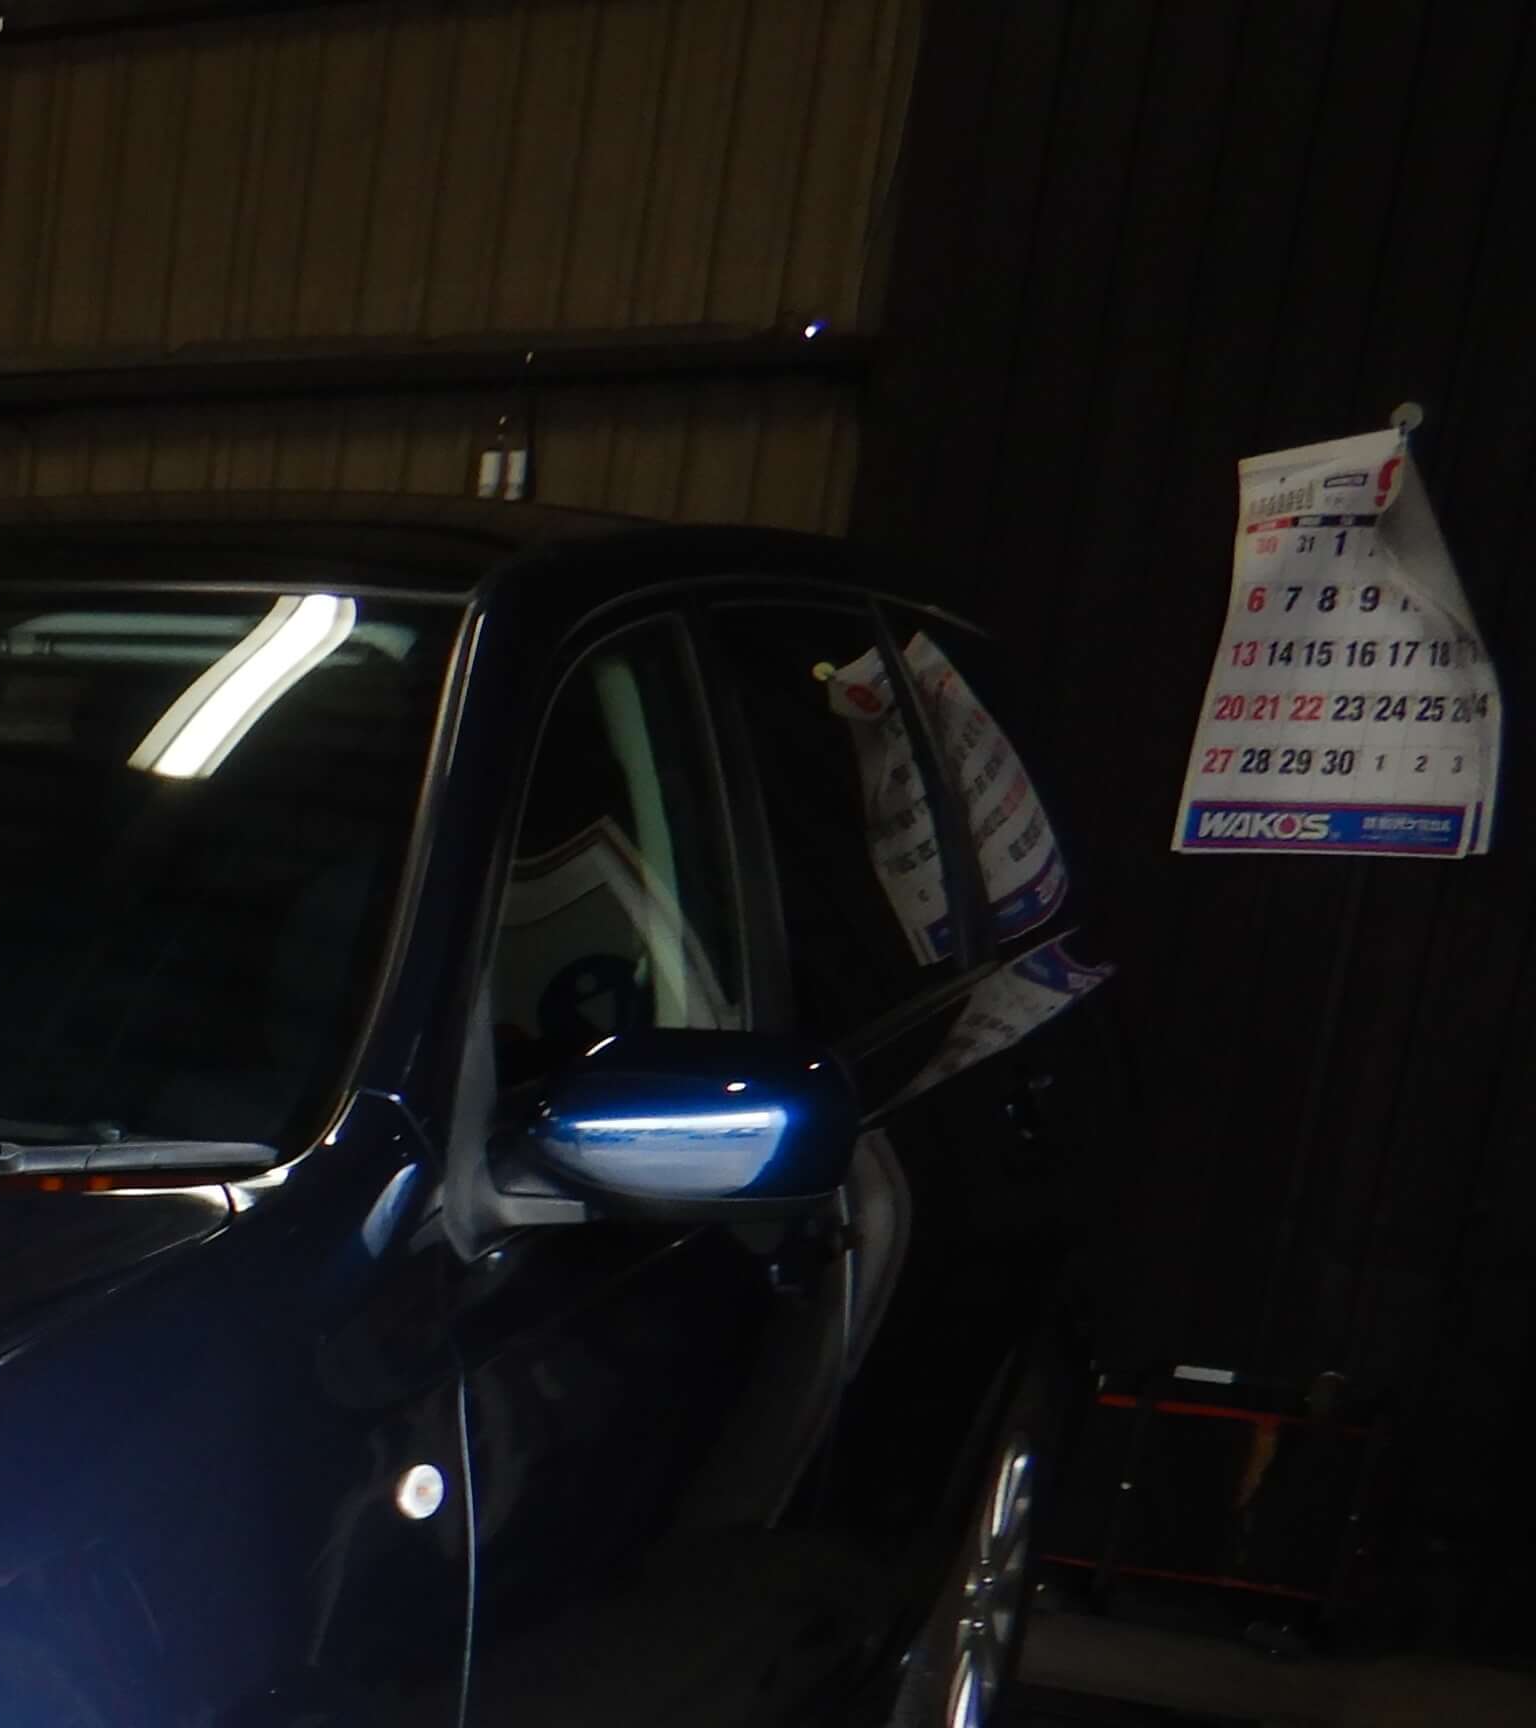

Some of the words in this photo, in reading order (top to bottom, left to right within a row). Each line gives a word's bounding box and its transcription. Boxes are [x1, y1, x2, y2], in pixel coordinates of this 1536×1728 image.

[1335, 531, 1347, 556] 1
[1247, 586, 1266, 613] 6
[1285, 586, 1303, 613] 7
[1317, 586, 1339, 613] 8
[1359, 586, 1381, 613] 9
[1230, 641, 1258, 668] 13
[1266, 641, 1292, 668] 14
[1304, 641, 1334, 668] 15
[1345, 641, 1377, 668] 16
[1388, 641, 1420, 668] 17
[1429, 641, 1451, 668] 18
[1214, 695, 1245, 721] 20
[1251, 695, 1280, 721] 21
[1288, 695, 1324, 721] 22
[1331, 695, 1365, 721] 23
[1373, 695, 1407, 721] 24
[1414, 695, 1445, 721] 25
[1201, 748, 1234, 774] 27
[1239, 748, 1271, 774] 28
[1278, 748, 1313, 774] 29
[1320, 749, 1356, 775] 30
[1374, 754, 1385, 772] 1
[1414, 754, 1429, 773] 2
[1451, 755, 1463, 773] 3
